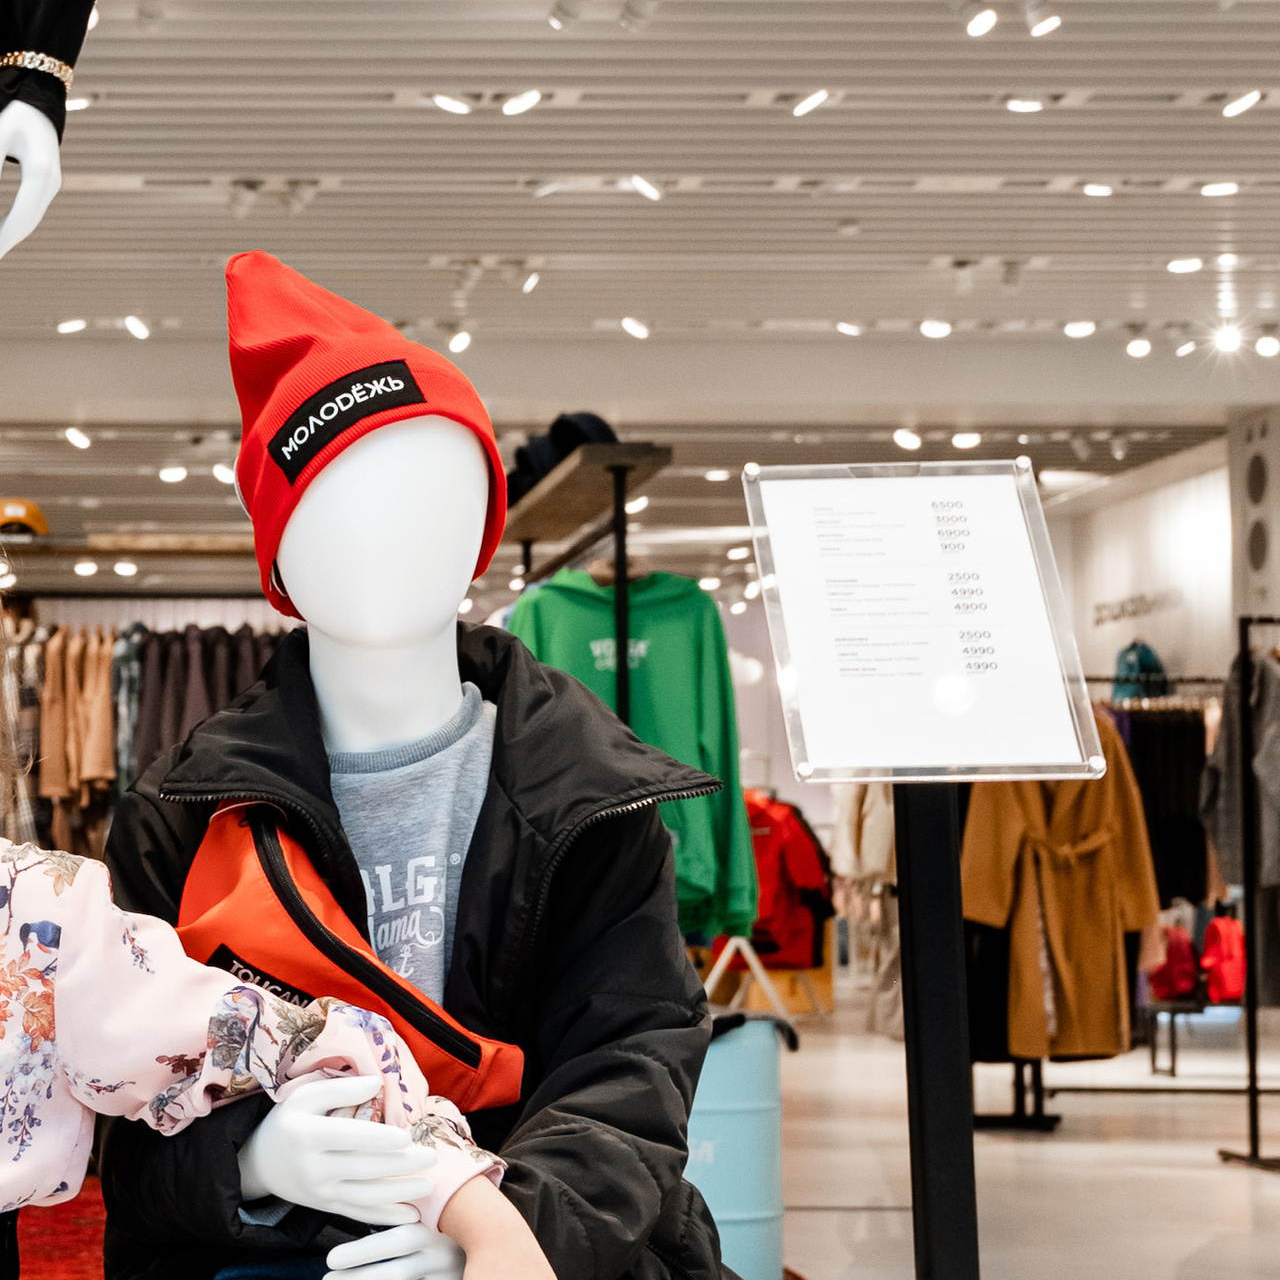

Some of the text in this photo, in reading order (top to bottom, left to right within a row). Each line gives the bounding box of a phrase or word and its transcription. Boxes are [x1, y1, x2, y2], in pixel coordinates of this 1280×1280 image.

[940, 542, 965, 551] 900
[948, 572, 980, 581] 2500
[951, 588, 983, 596] 4990
[954, 603, 987, 611] 4900
[959, 630, 991, 639] 2500
[962, 646, 995, 655] 4990
[965, 661, 998, 670] 4990
